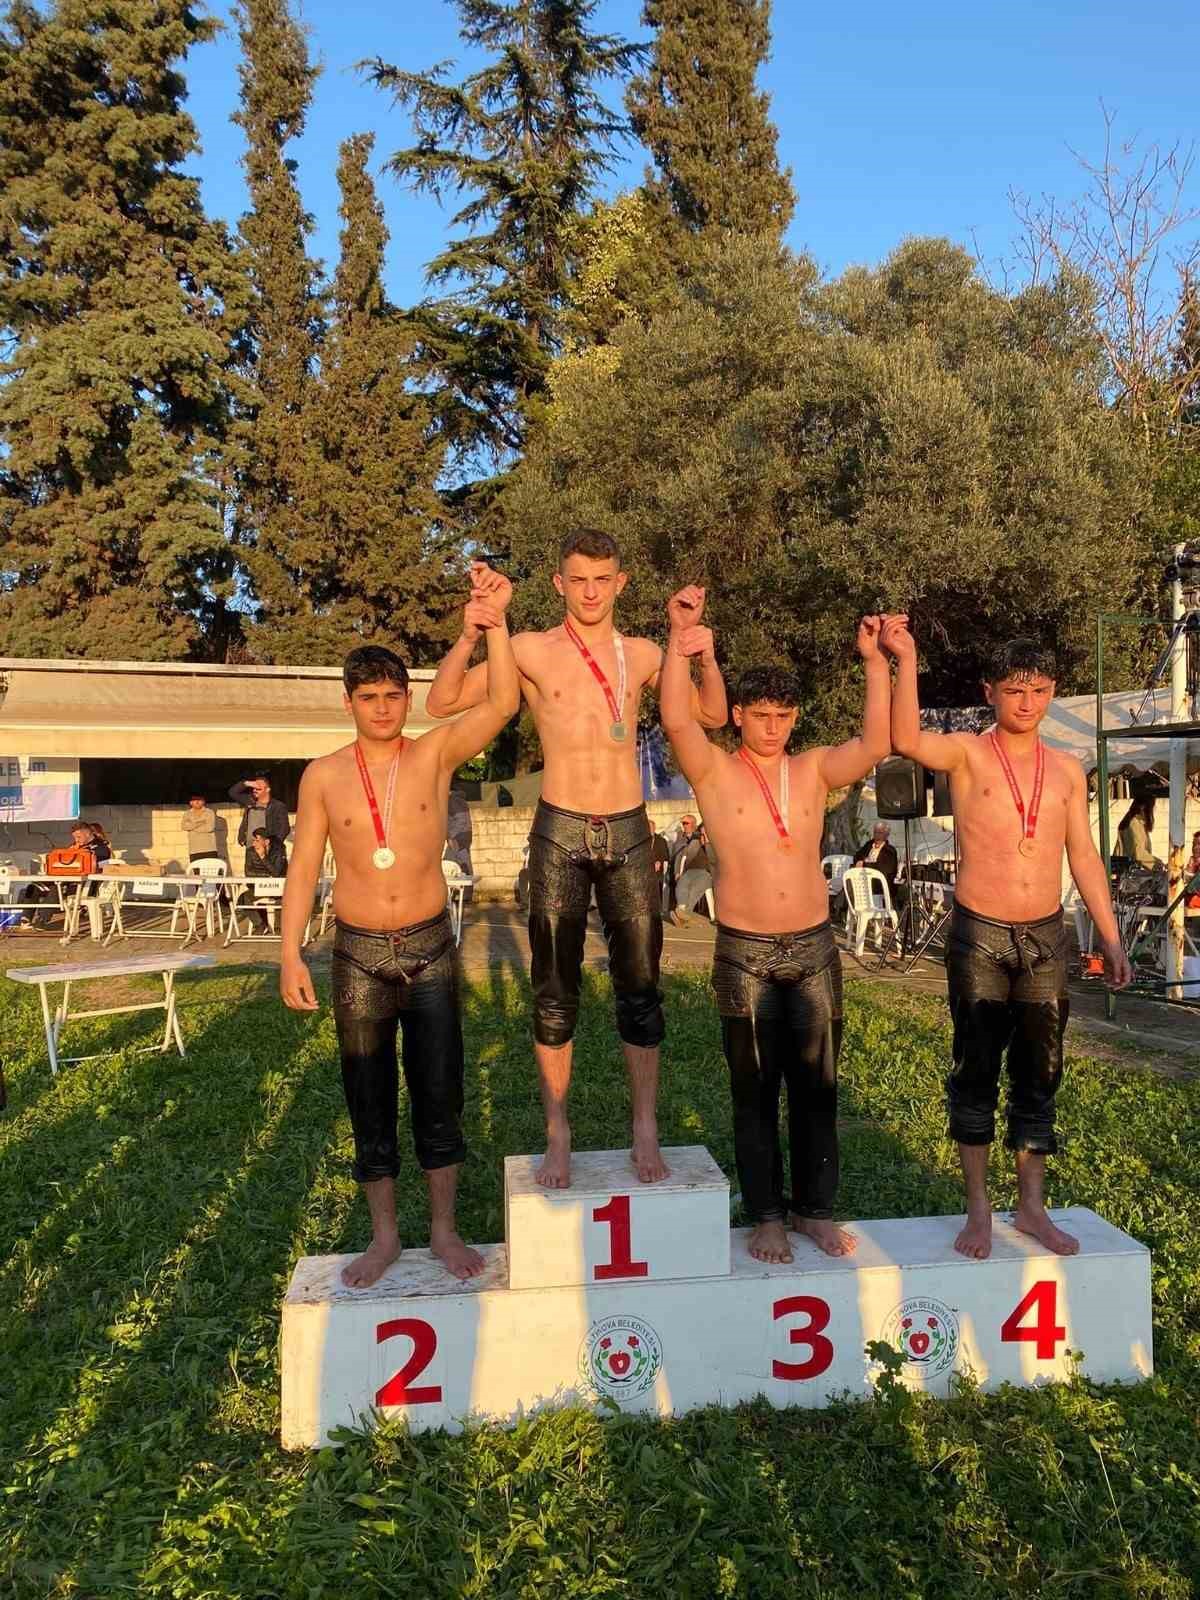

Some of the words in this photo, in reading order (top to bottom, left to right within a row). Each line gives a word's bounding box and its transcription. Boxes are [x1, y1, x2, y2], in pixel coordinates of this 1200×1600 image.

[593, 1196, 648, 1280] 1
[375, 1318, 442, 1407] 2
[772, 1296, 834, 1381] 3
[1001, 1281, 1065, 1360] 4
